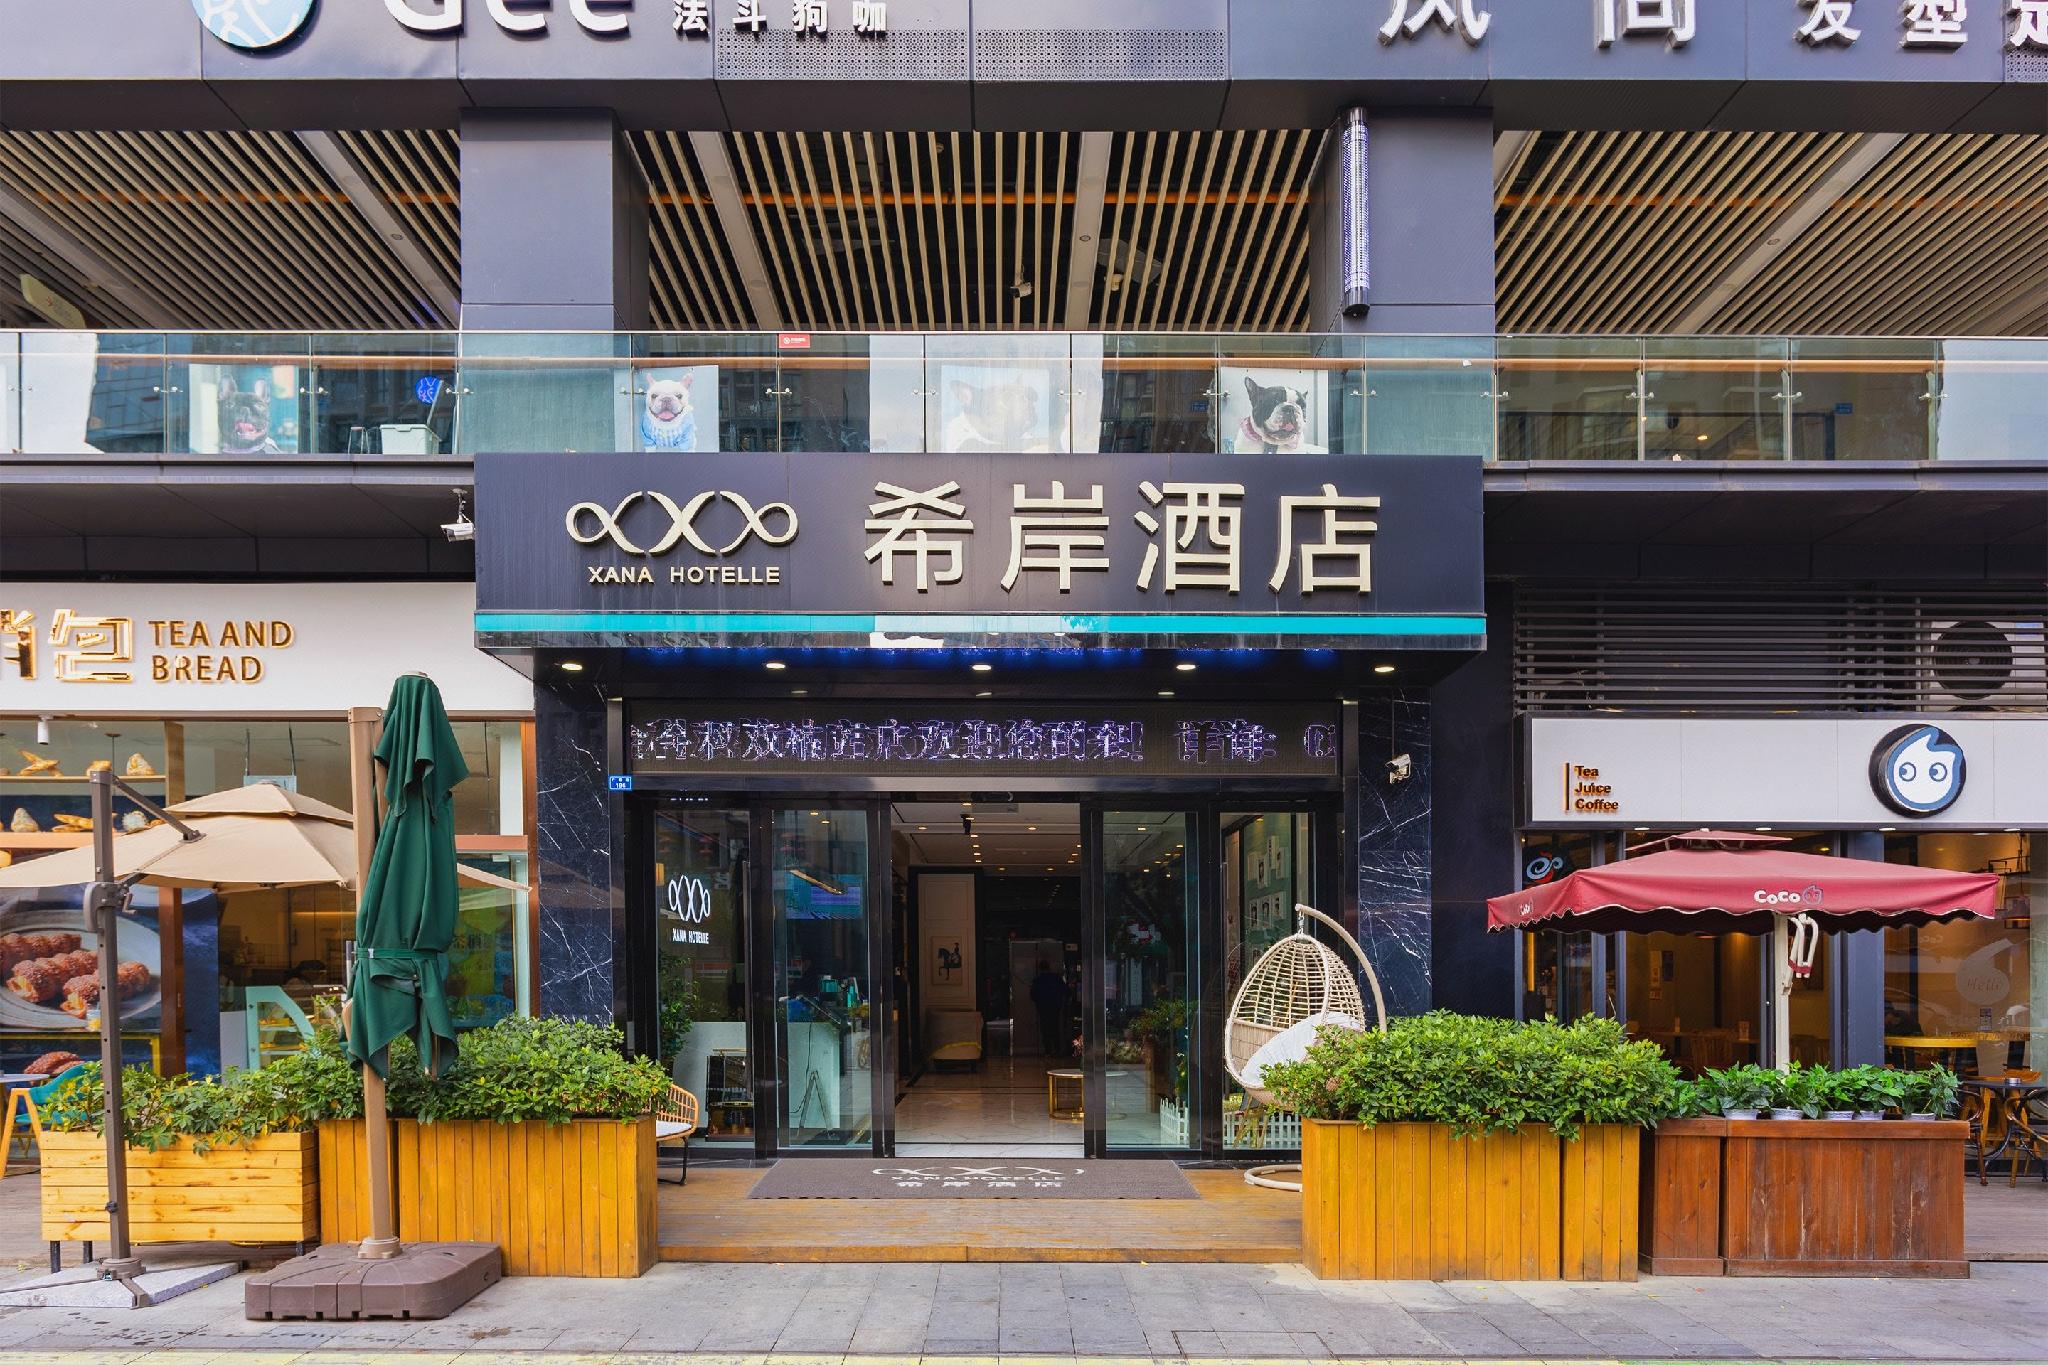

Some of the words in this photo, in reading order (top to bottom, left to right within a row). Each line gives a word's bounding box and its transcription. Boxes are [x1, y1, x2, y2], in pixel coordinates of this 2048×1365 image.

[864, 481, 1382, 594] 希岸酒店
[588, 566, 654, 583] XANA
[670, 566, 780, 583] HOTELLE
[148, 620, 210, 647] TEA
[219, 620, 293, 647] AND
[152, 655, 264, 682] BREAD
[1574, 765, 1599, 777] Tea
[1574, 782, 1611, 794] Juice
[1575, 798, 1618, 810] Coffee
